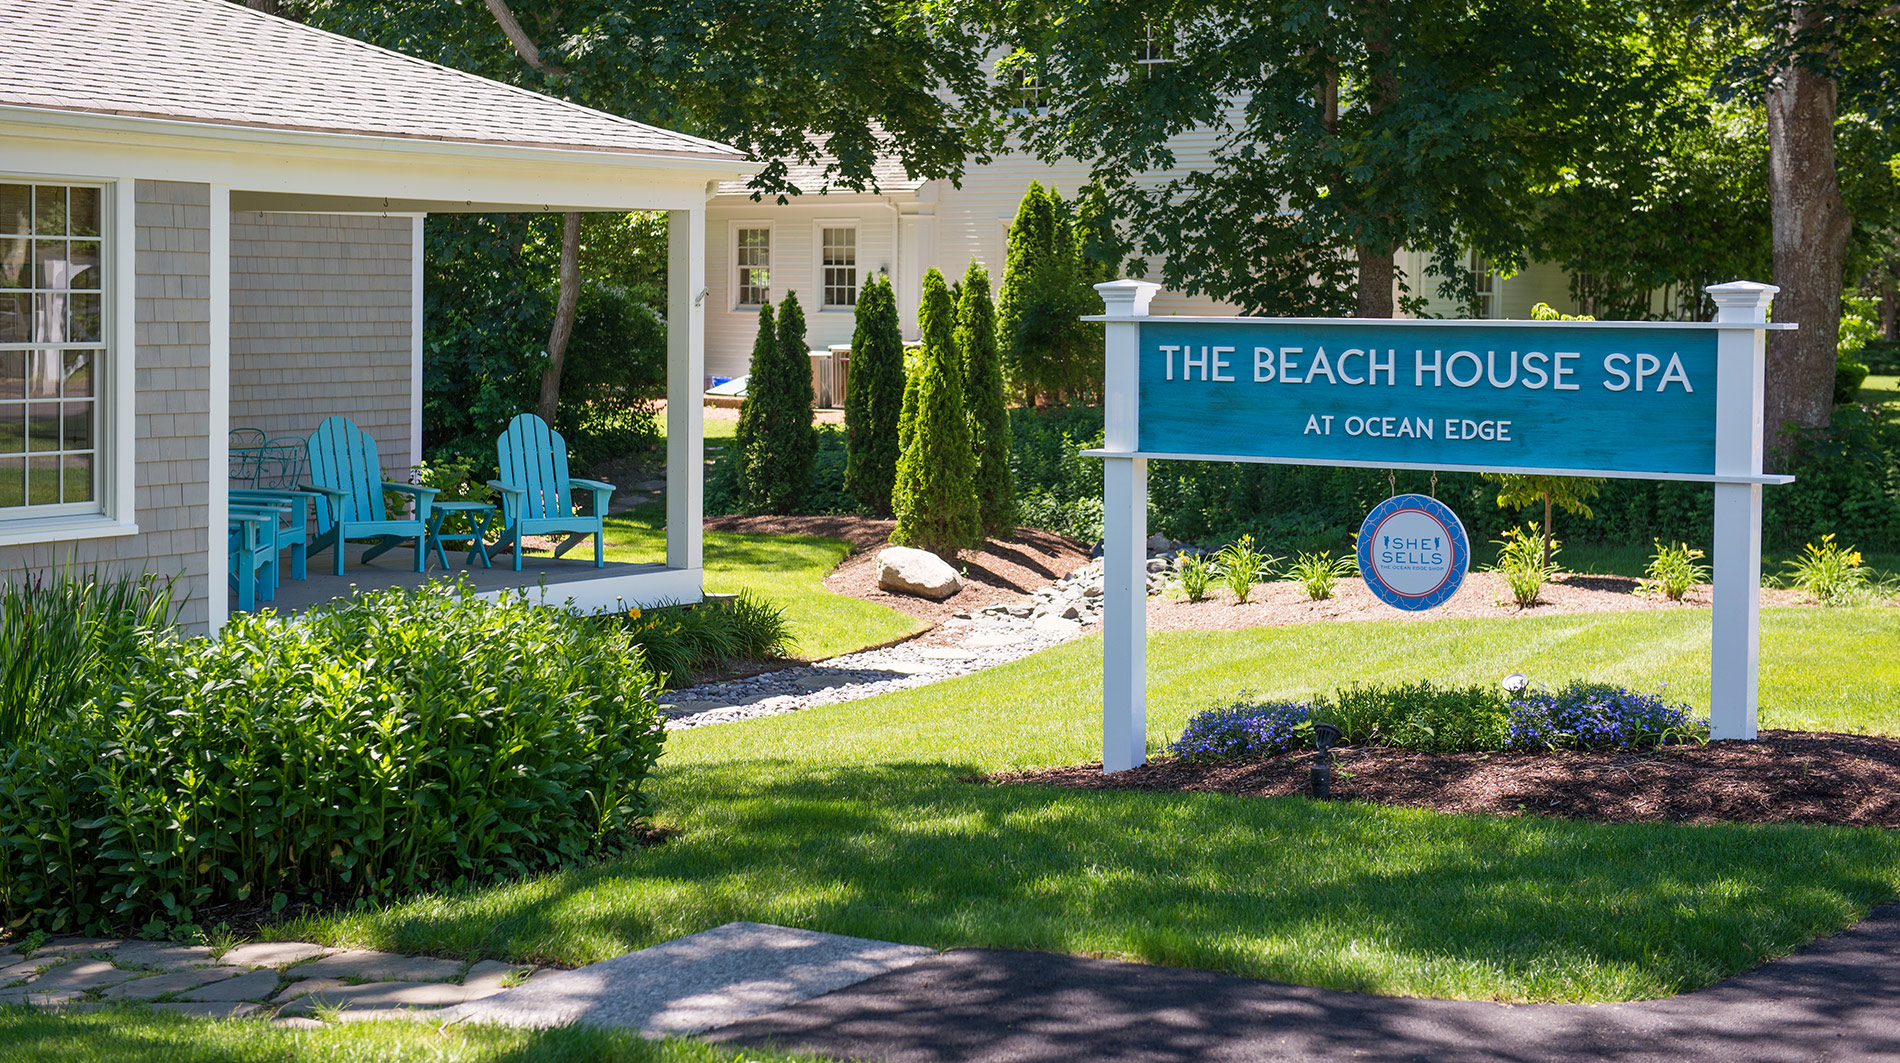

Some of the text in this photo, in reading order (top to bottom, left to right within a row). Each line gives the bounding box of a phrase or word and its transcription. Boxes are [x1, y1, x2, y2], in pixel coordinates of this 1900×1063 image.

[1158, 345, 1694, 393] THE BEACH HOUSE SPA
[1303, 414, 1512, 441] AT OCEAN EDGE
[1392, 537, 1432, 550] SHE
[1381, 551, 1443, 565] SELLS
